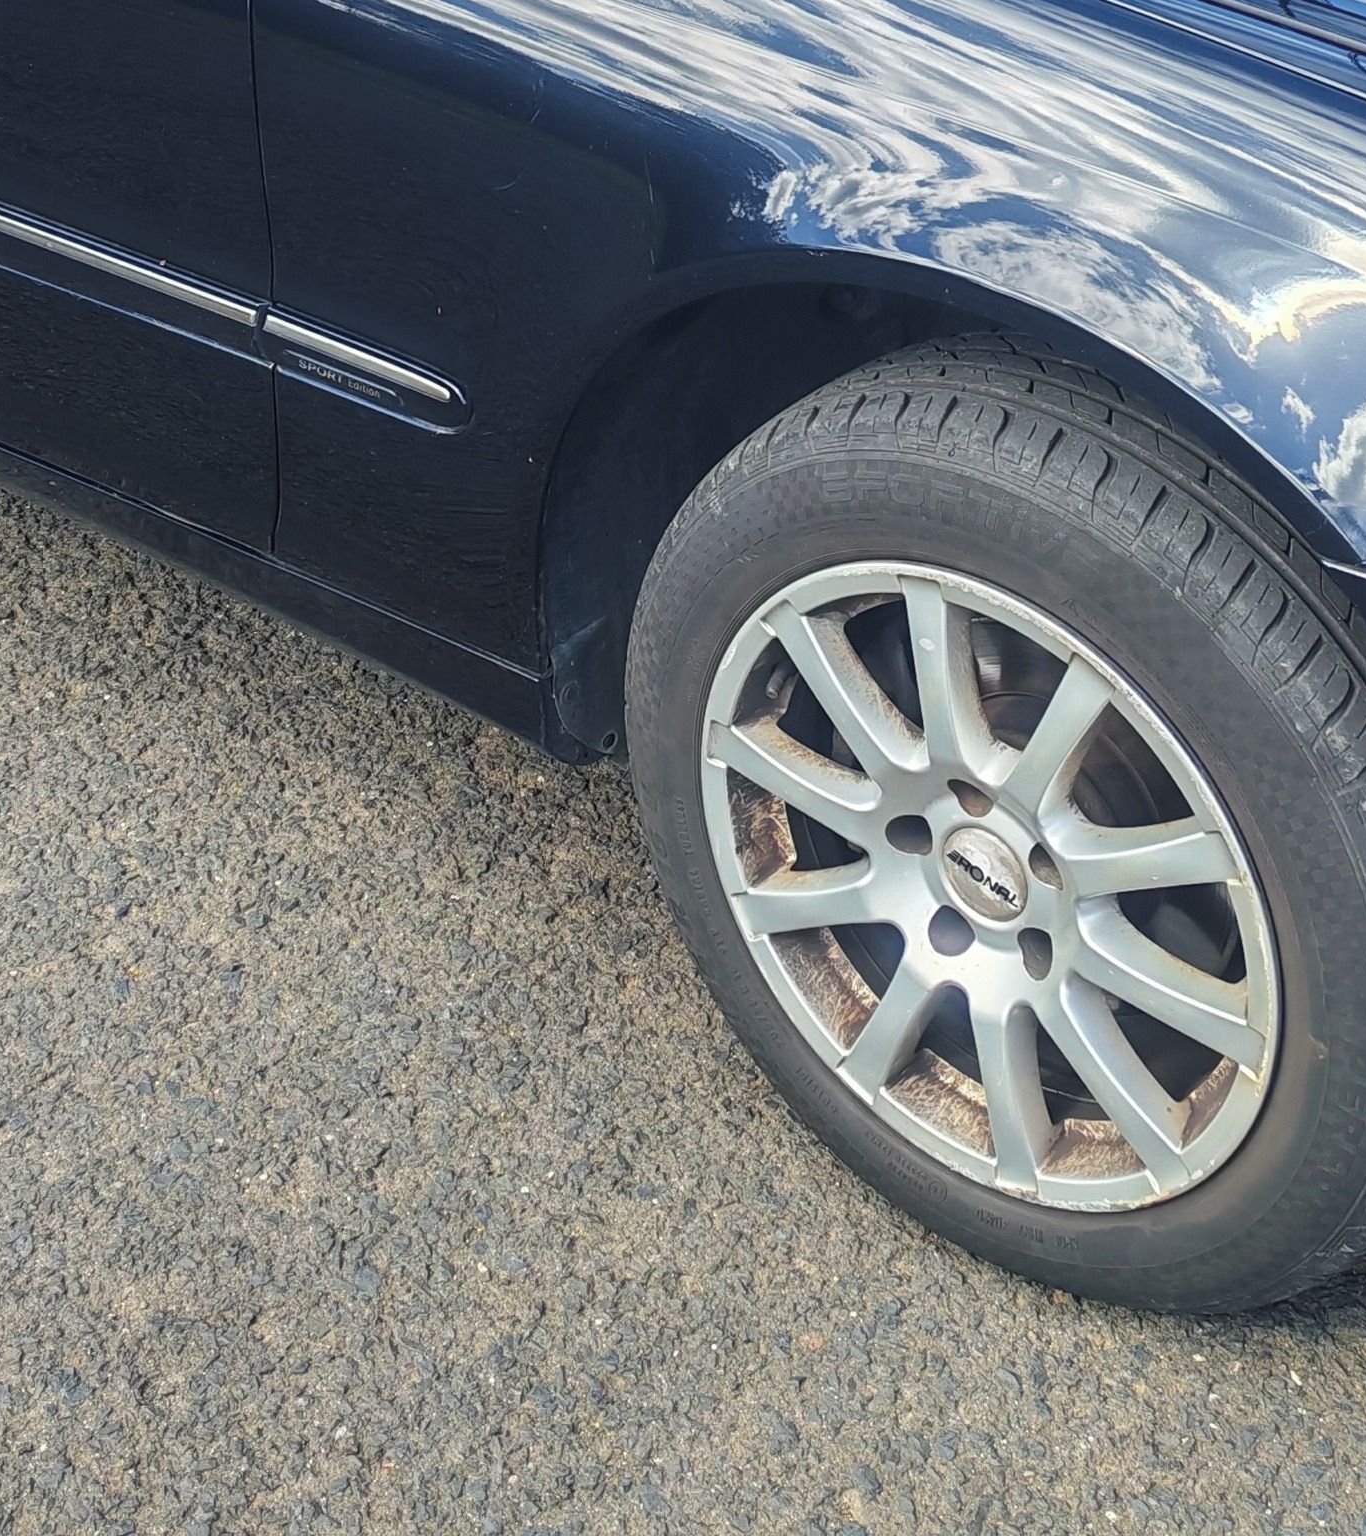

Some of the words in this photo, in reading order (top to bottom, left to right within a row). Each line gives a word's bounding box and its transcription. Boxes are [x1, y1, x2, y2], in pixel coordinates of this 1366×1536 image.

[298, 358, 344, 384] SPORT
[347, 380, 381, 400] Edition
[956, 852, 1019, 908] RONAL
